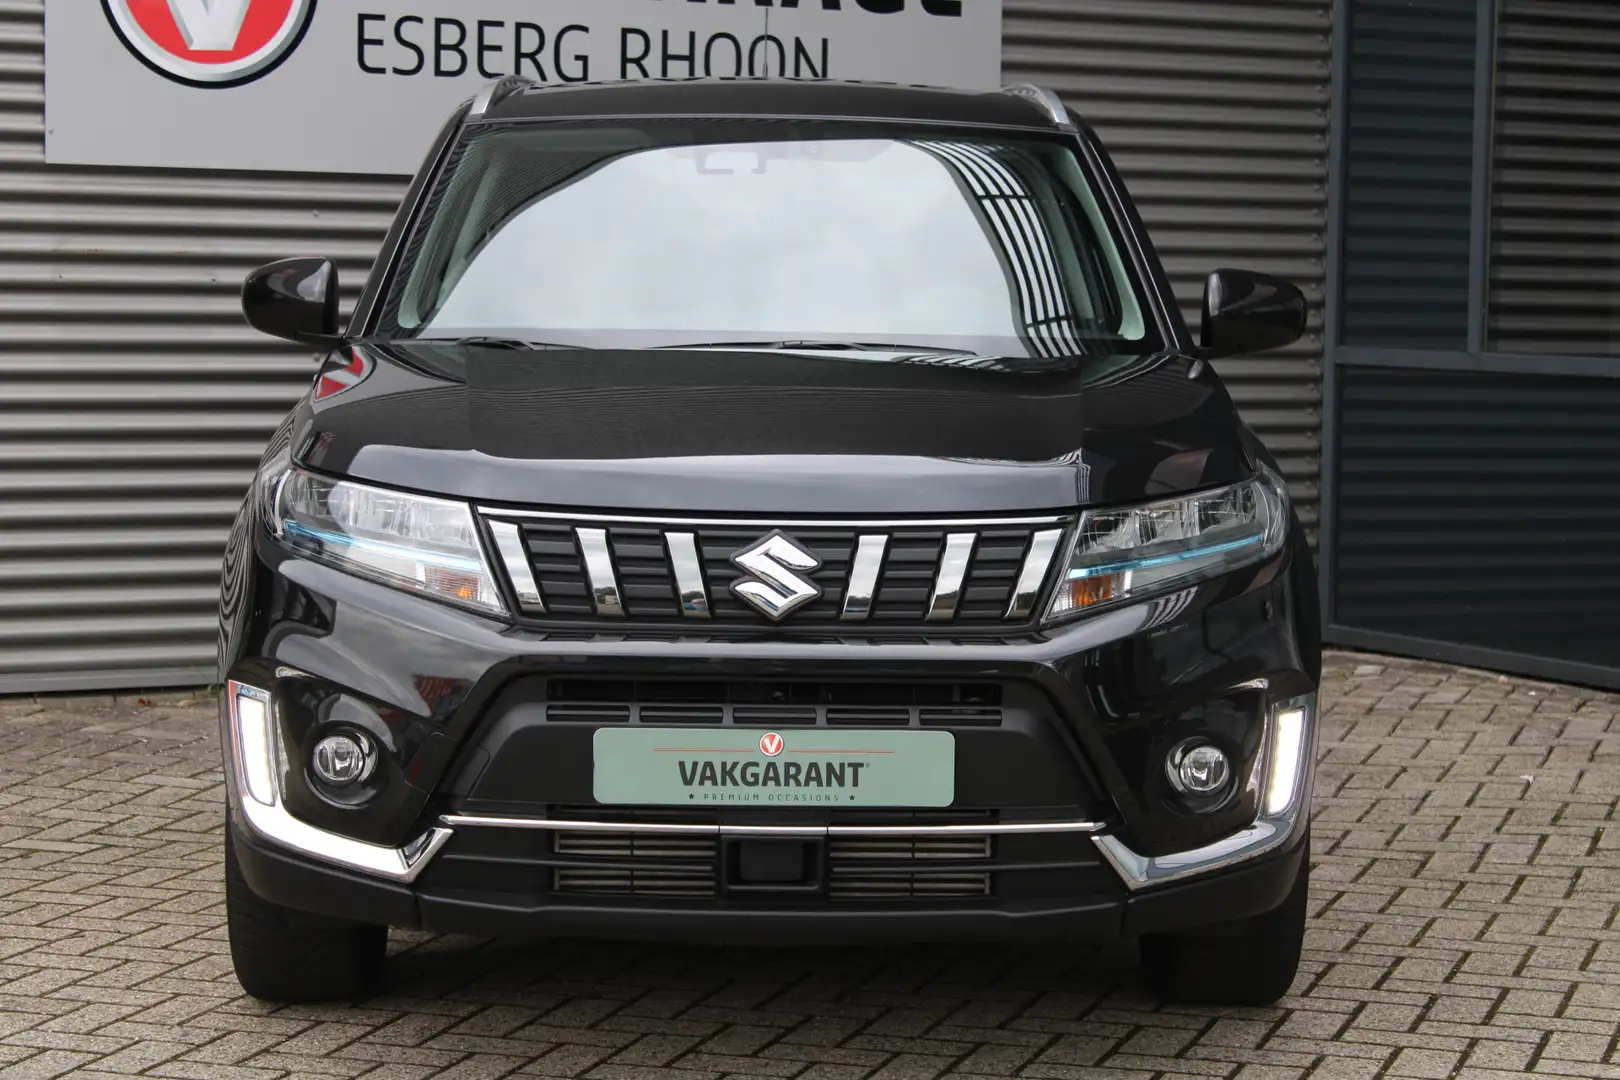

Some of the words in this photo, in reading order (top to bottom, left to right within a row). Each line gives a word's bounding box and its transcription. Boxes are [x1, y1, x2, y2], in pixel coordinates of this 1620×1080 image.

[357, 13, 589, 83] ESBERG
[620, 27, 829, 78] RHOON
[703, 793, 760, 801] PREMIUM
[768, 793, 839, 802] OCCASIONS
